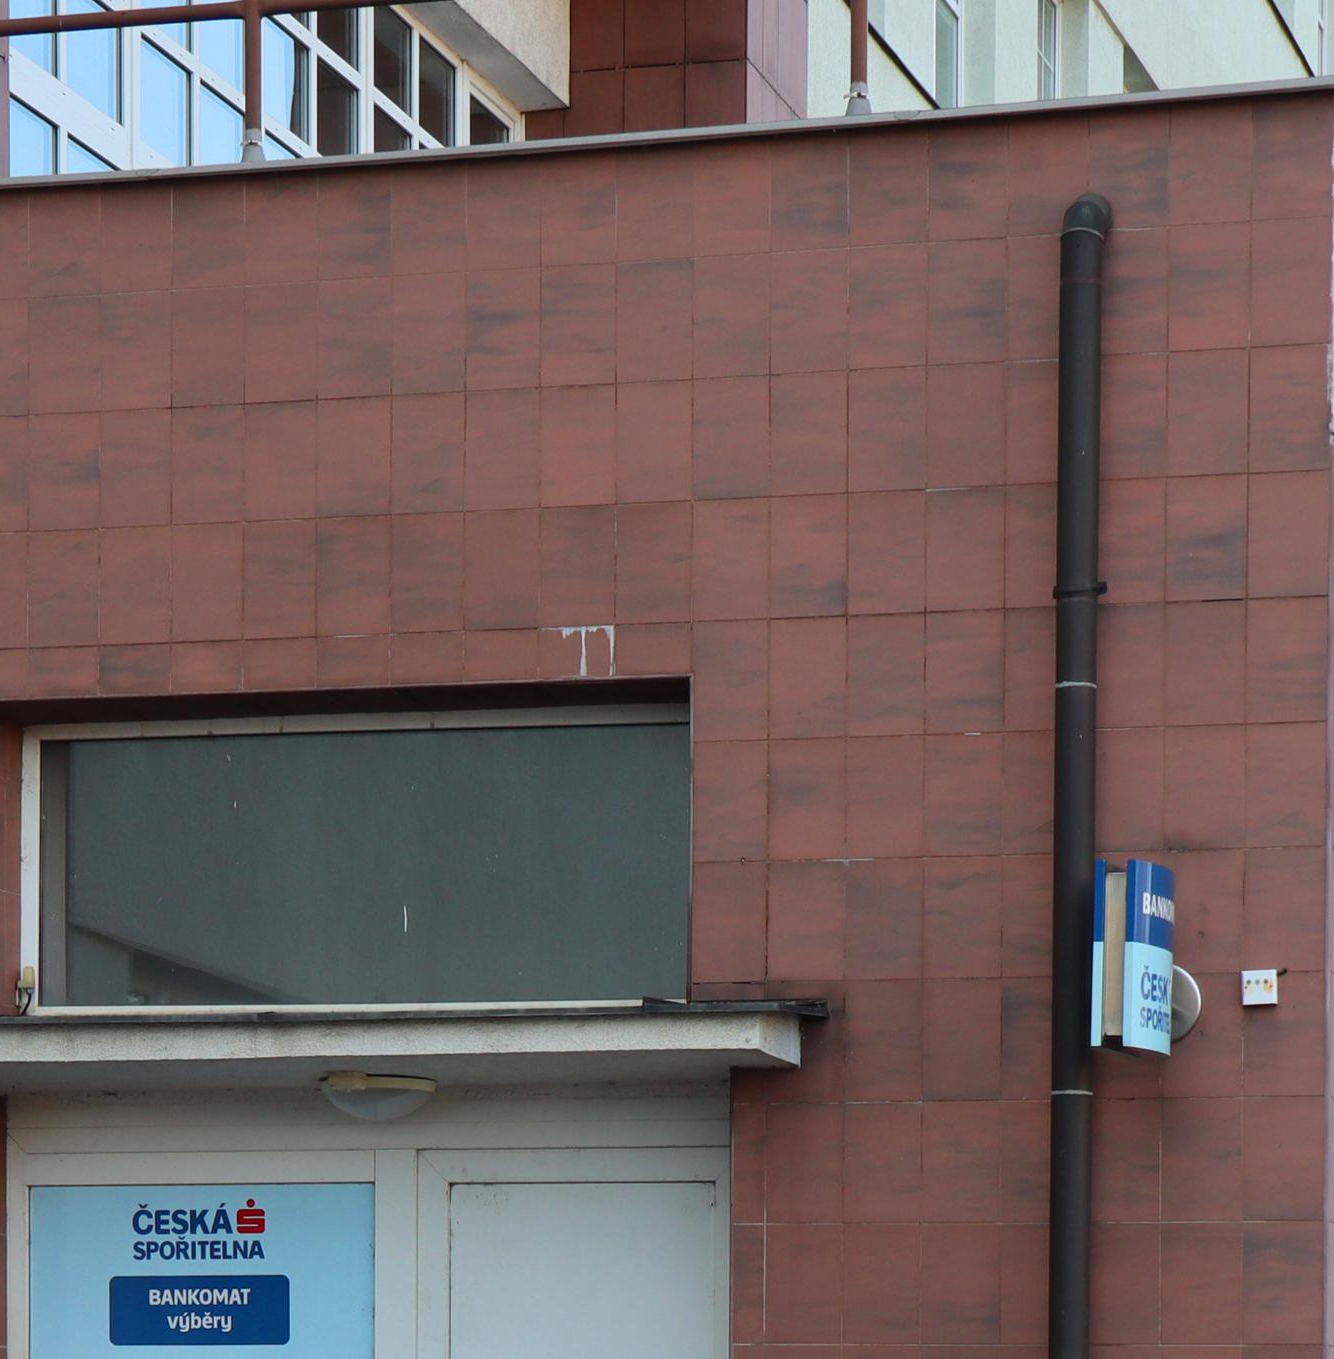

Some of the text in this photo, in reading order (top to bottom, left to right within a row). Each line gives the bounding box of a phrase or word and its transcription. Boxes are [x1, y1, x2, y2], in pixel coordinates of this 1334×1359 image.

[1141, 964, 1171, 1005] ČESK
[132, 1202, 233, 1235] ČESKÁ
[133, 1236, 265, 1260] SPOŘITELNA
[149, 1288, 251, 1306] BANKOMAT
[167, 1312, 232, 1333] výběry
